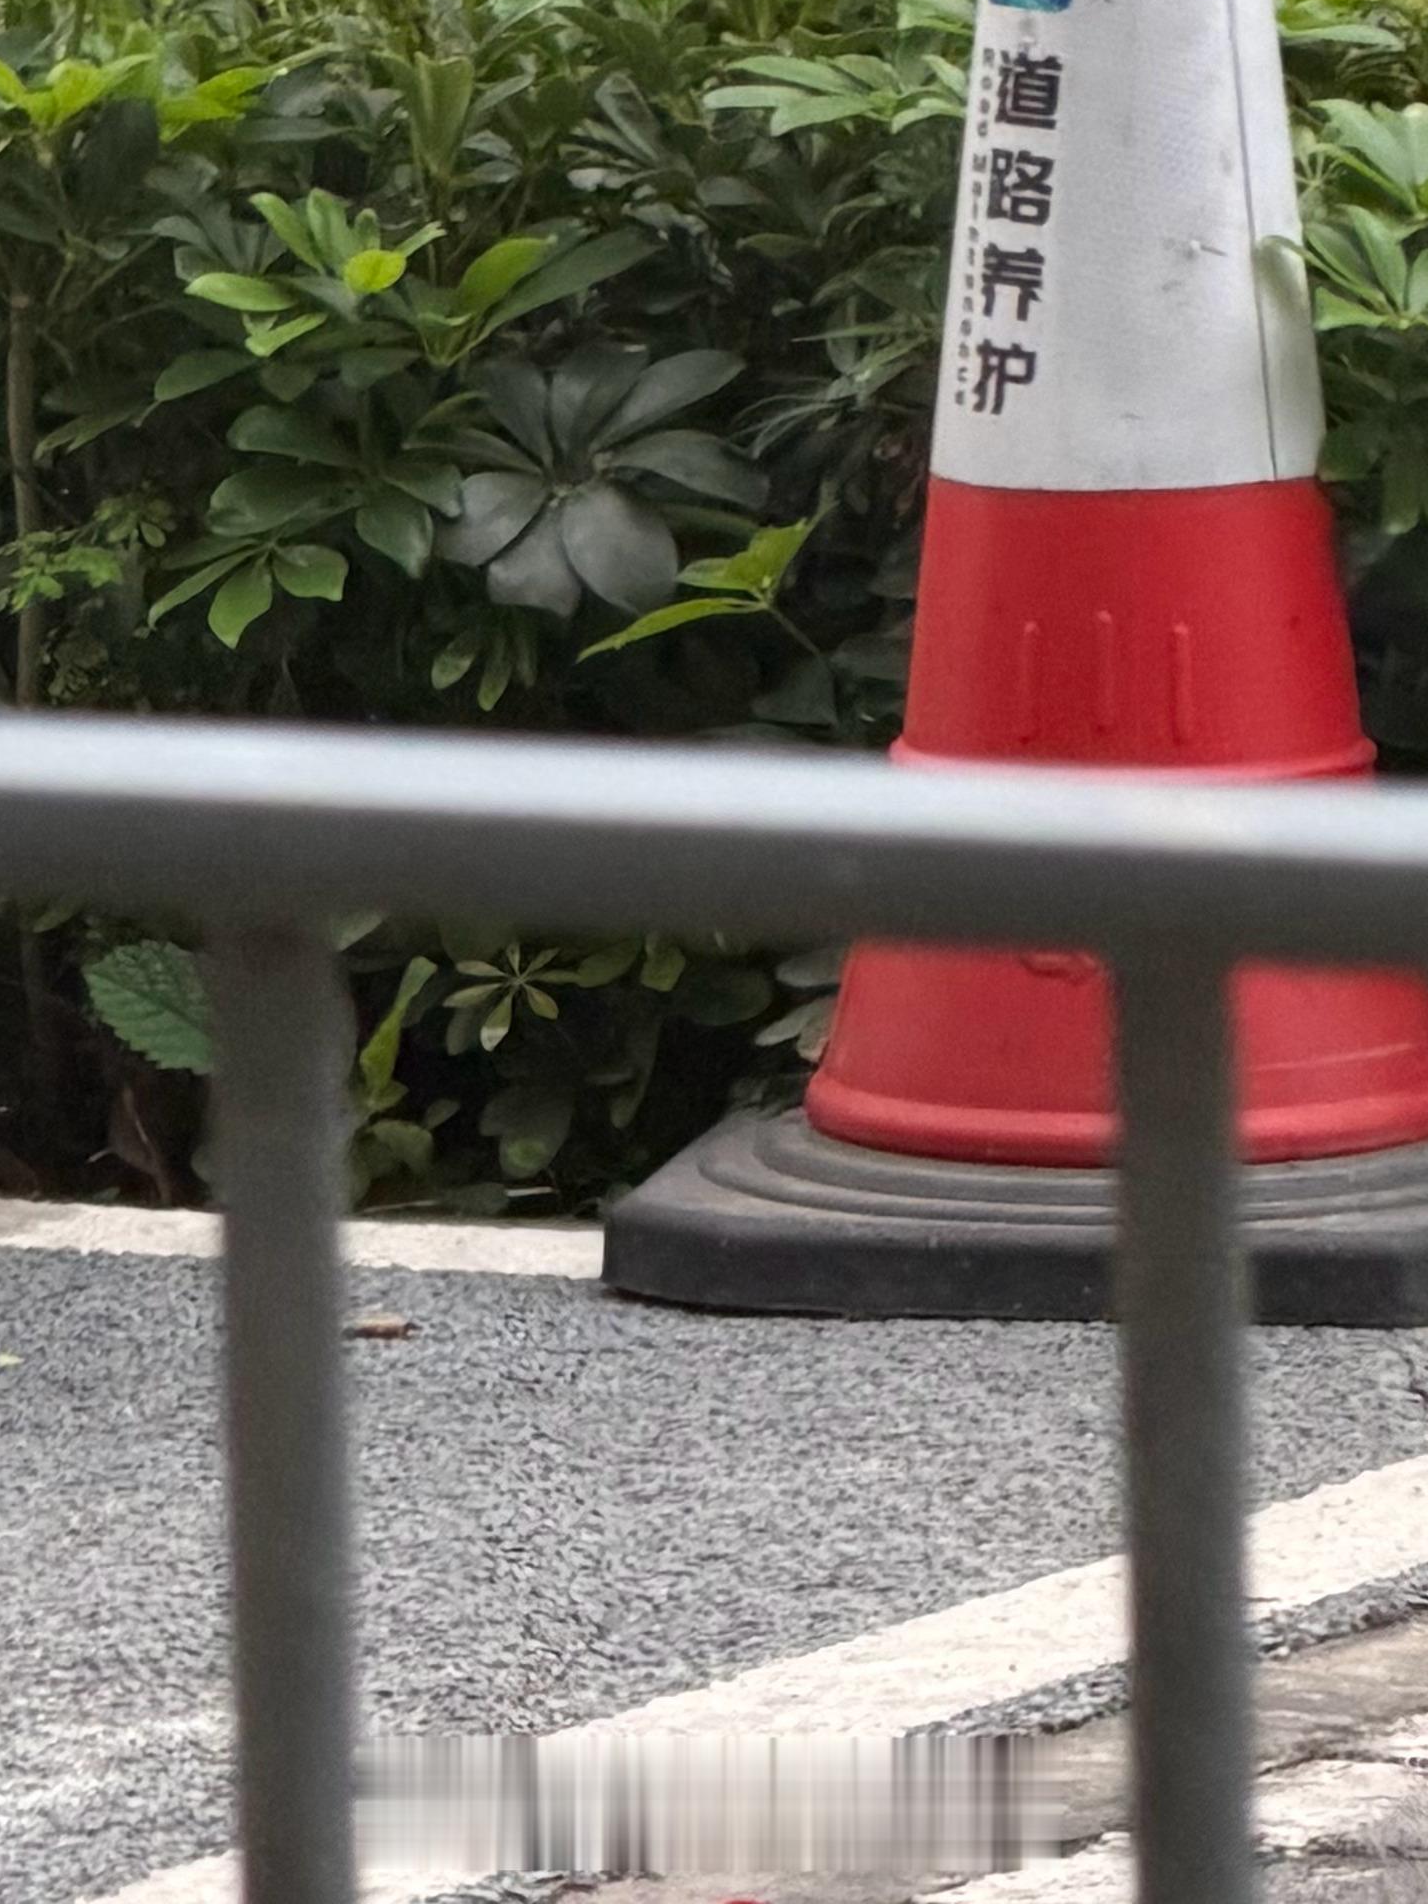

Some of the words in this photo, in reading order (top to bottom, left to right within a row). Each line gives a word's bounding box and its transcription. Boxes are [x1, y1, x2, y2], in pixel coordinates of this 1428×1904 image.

[976, 47, 996, 138] Road
[954, 152, 989, 407] Maintenance
[972, 50, 1063, 416] 道路养护
